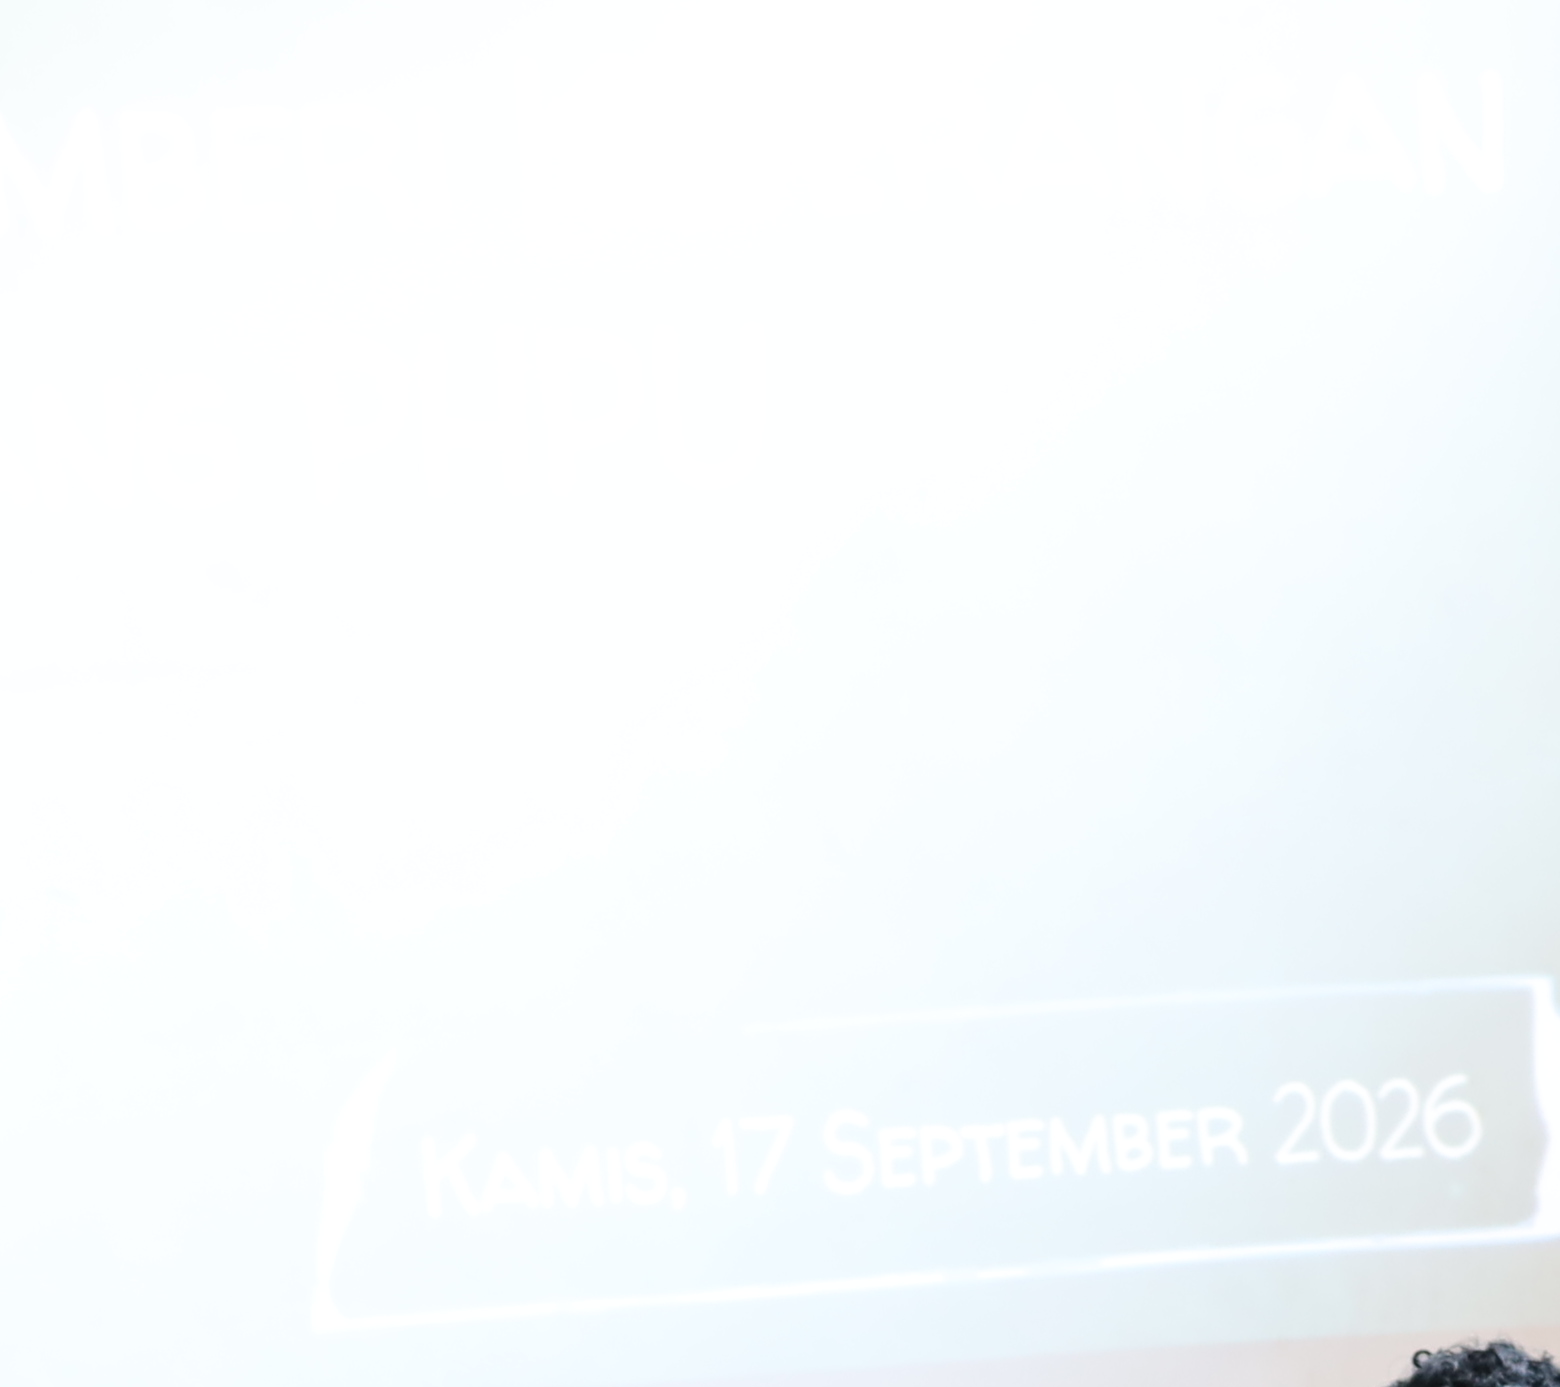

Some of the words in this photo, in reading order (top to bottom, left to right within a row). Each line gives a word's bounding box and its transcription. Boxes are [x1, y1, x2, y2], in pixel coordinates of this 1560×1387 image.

[711, 1113, 795, 1199] 17
[821, 1106, 1250, 1198] SEPTEMBER
[1270, 1072, 1485, 1165] 2026
